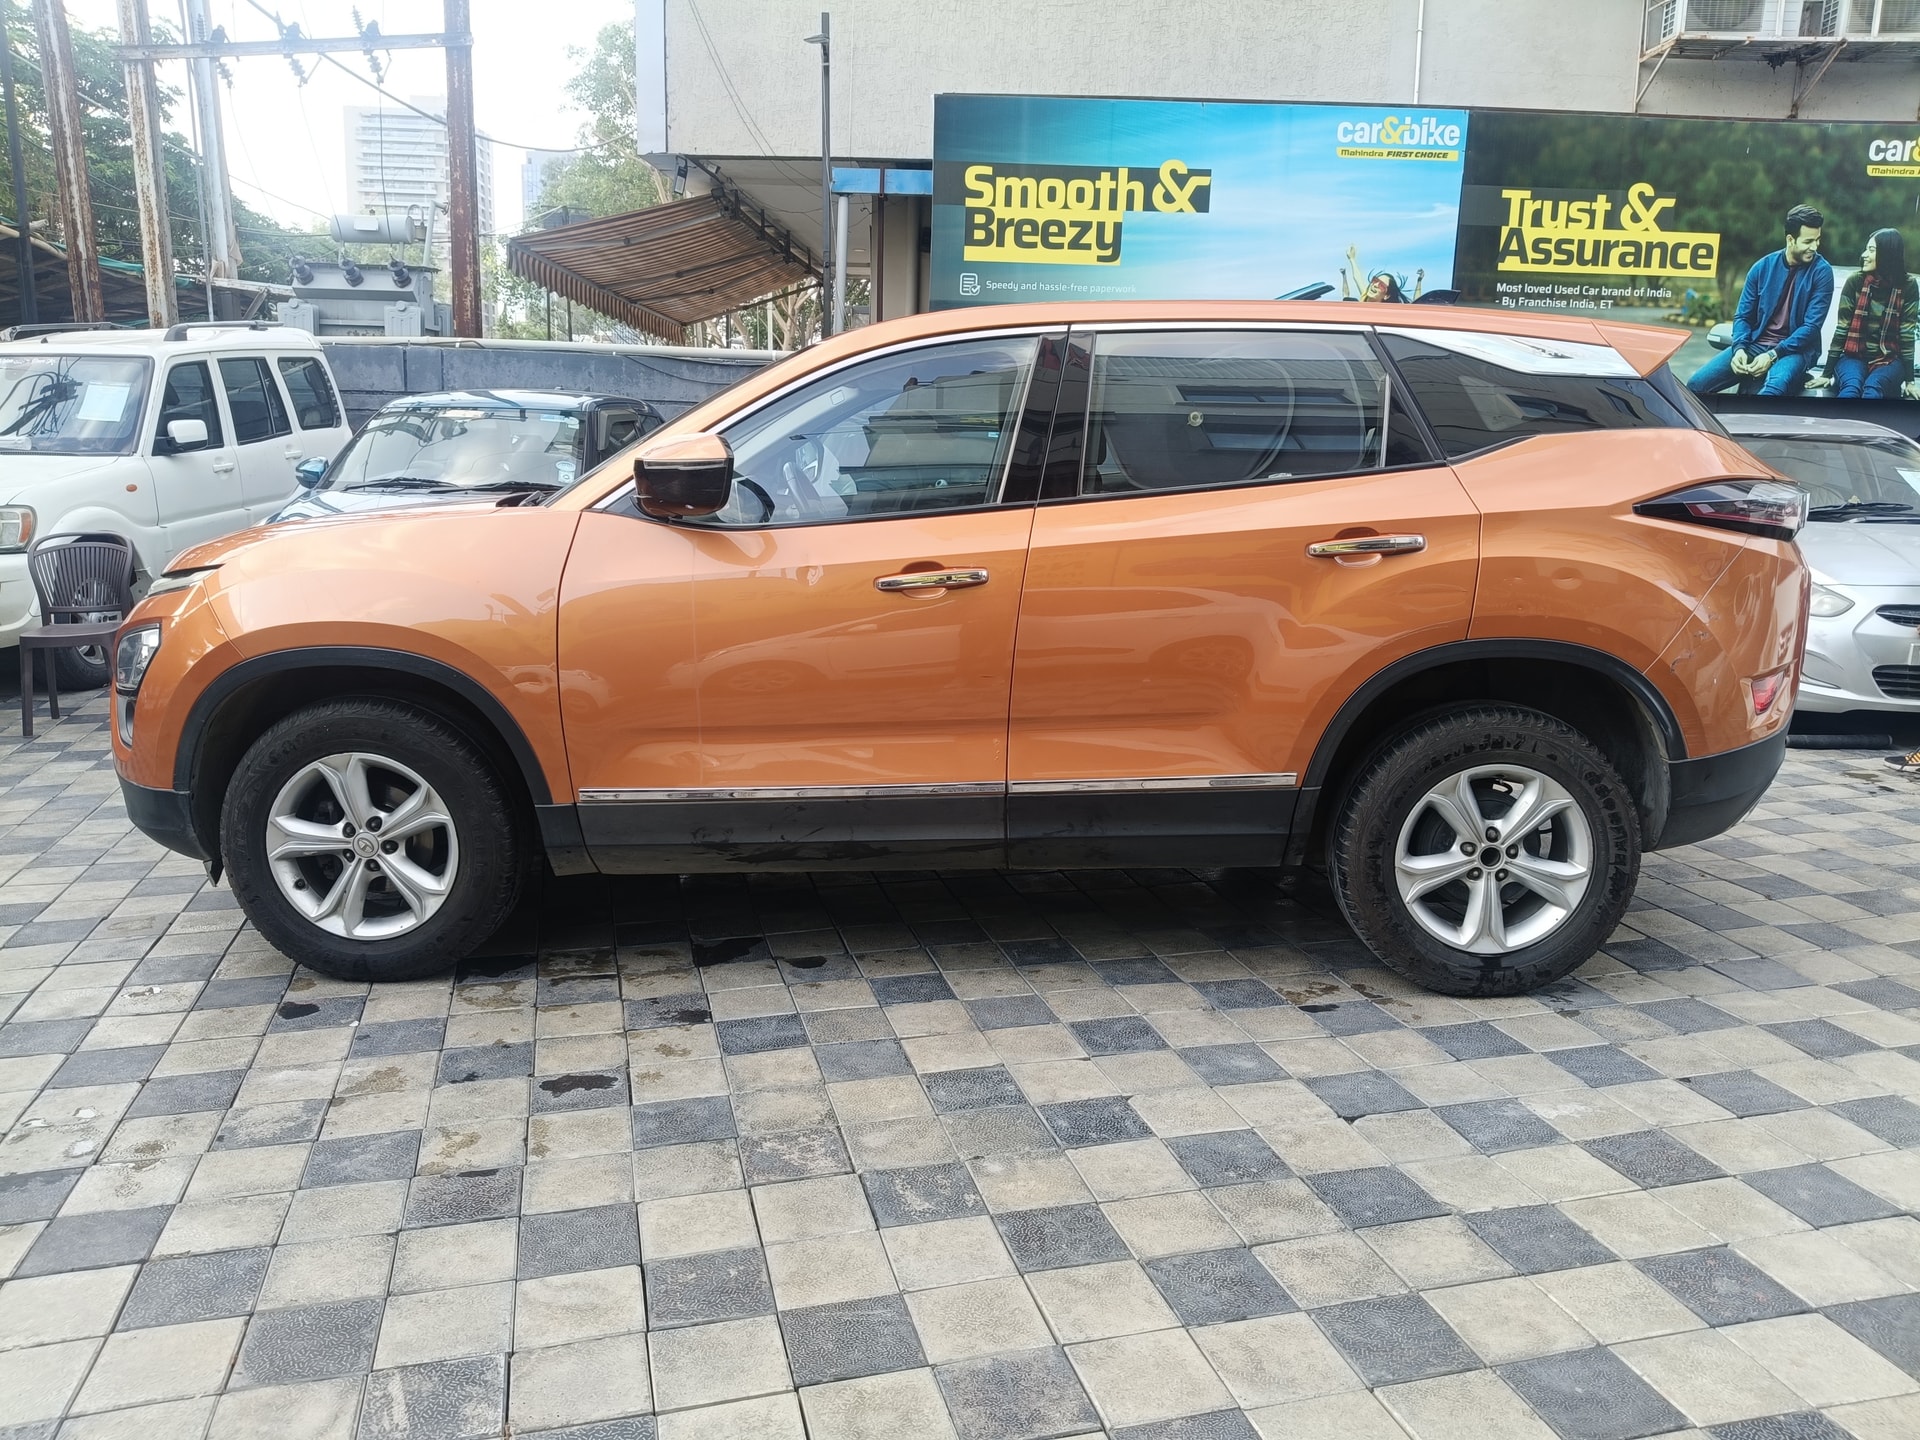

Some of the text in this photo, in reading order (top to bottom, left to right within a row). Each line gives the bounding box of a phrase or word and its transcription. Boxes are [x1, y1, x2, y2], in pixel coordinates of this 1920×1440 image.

[1337, 116, 1460, 146] car&bike
[1340, 149, 1449, 159] Mahindra FIRST CHOICE
[1869, 136, 1920, 162] car
[964, 159, 1212, 213] Smooth &
[1501, 182, 1676, 232] Trust &
[965, 206, 1123, 263] Breezy
[1497, 227, 1714, 271] Assurance
[986, 280, 1137, 295] Speedy and hassle-free paperwork
[1496, 283, 1672, 298] Most loved Used Car brand of India
[1502, 297, 1515, 308] By
[1518, 297, 1567, 308] Franchise
[1569, 299, 1597, 310] India,
[1600, 300, 1613, 309] ET
